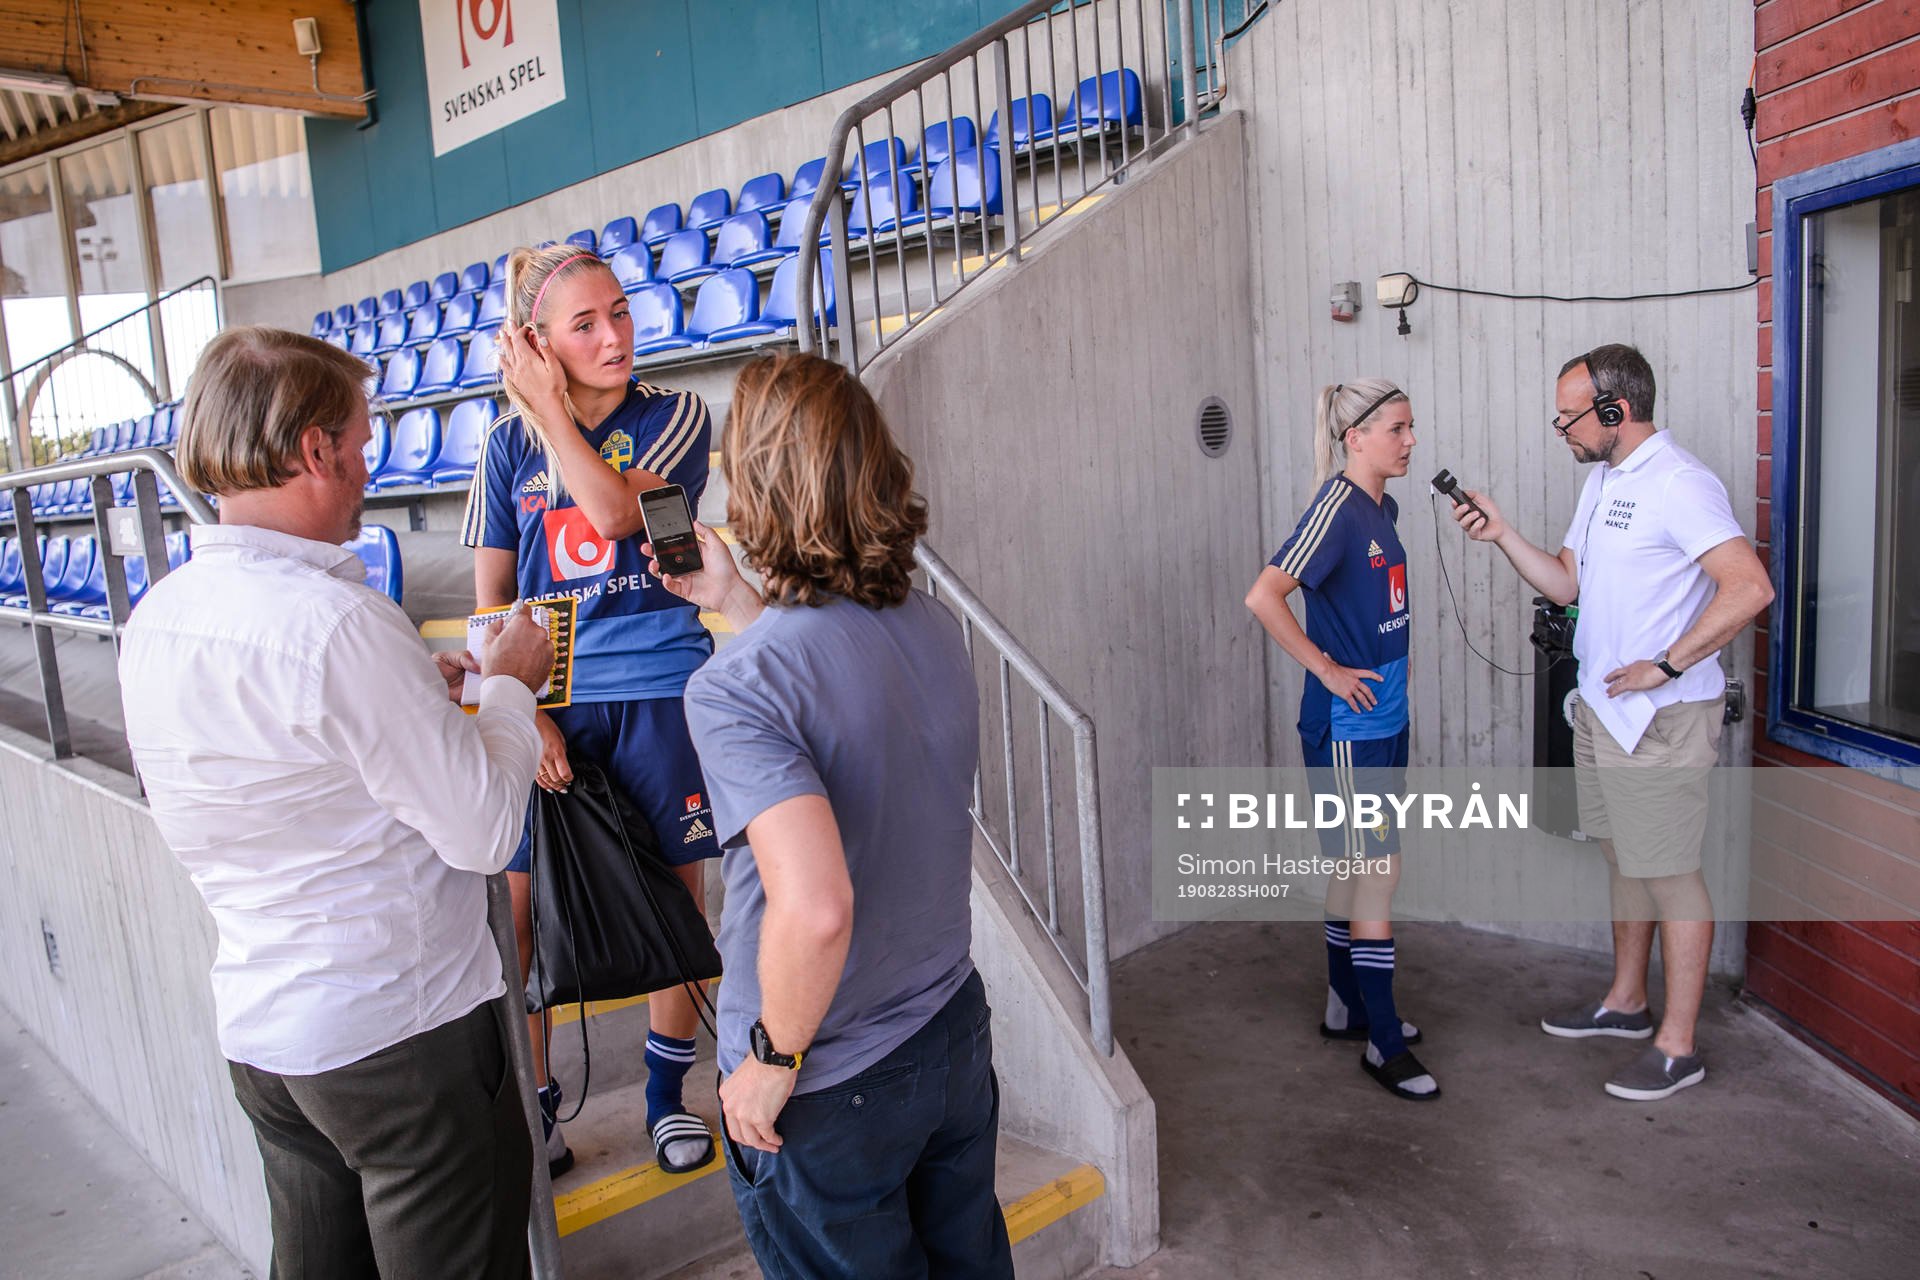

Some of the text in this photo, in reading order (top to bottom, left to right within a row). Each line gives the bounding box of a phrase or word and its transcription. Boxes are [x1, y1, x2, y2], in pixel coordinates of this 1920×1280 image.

[444, 56, 545, 122] SVENSKA SPEL
[522, 483, 549, 493] adida
[519, 495, 547, 514] ICA
[1612, 499, 1636, 509] PEAKP
[1608, 509, 1633, 519] ERFOR
[1604, 520, 1629, 530] MANCE
[1369, 556, 1387, 568] ICA
[607, 574, 651, 594] SPEL
[683, 829, 713, 844] adidas
